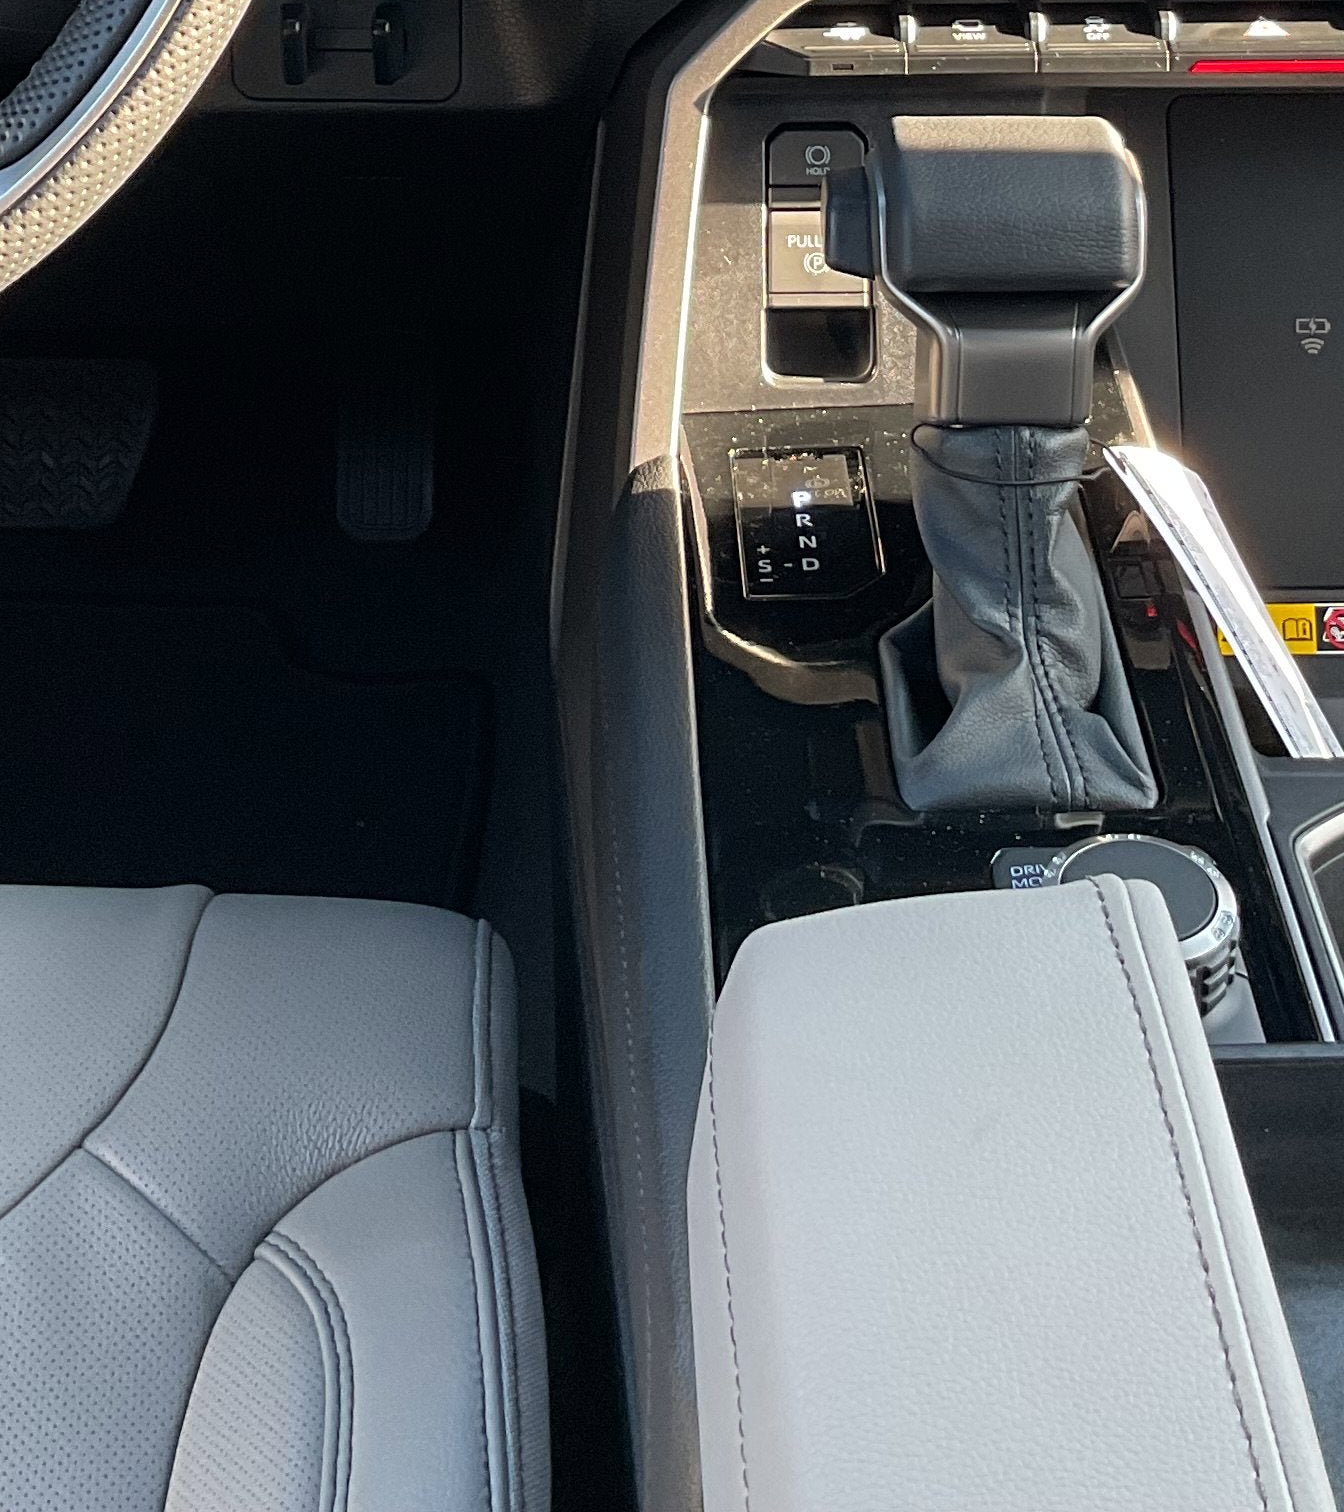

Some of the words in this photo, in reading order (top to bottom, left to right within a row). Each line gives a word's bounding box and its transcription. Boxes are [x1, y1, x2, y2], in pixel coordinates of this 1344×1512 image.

[787, 234, 823, 248] PULL
[791, 491, 812, 508] P
[795, 513, 814, 527] R
[798, 535, 817, 549] N
[758, 559, 773, 573] S
[801, 557, 820, 571] D
[1011, 876, 1043, 889] MO
